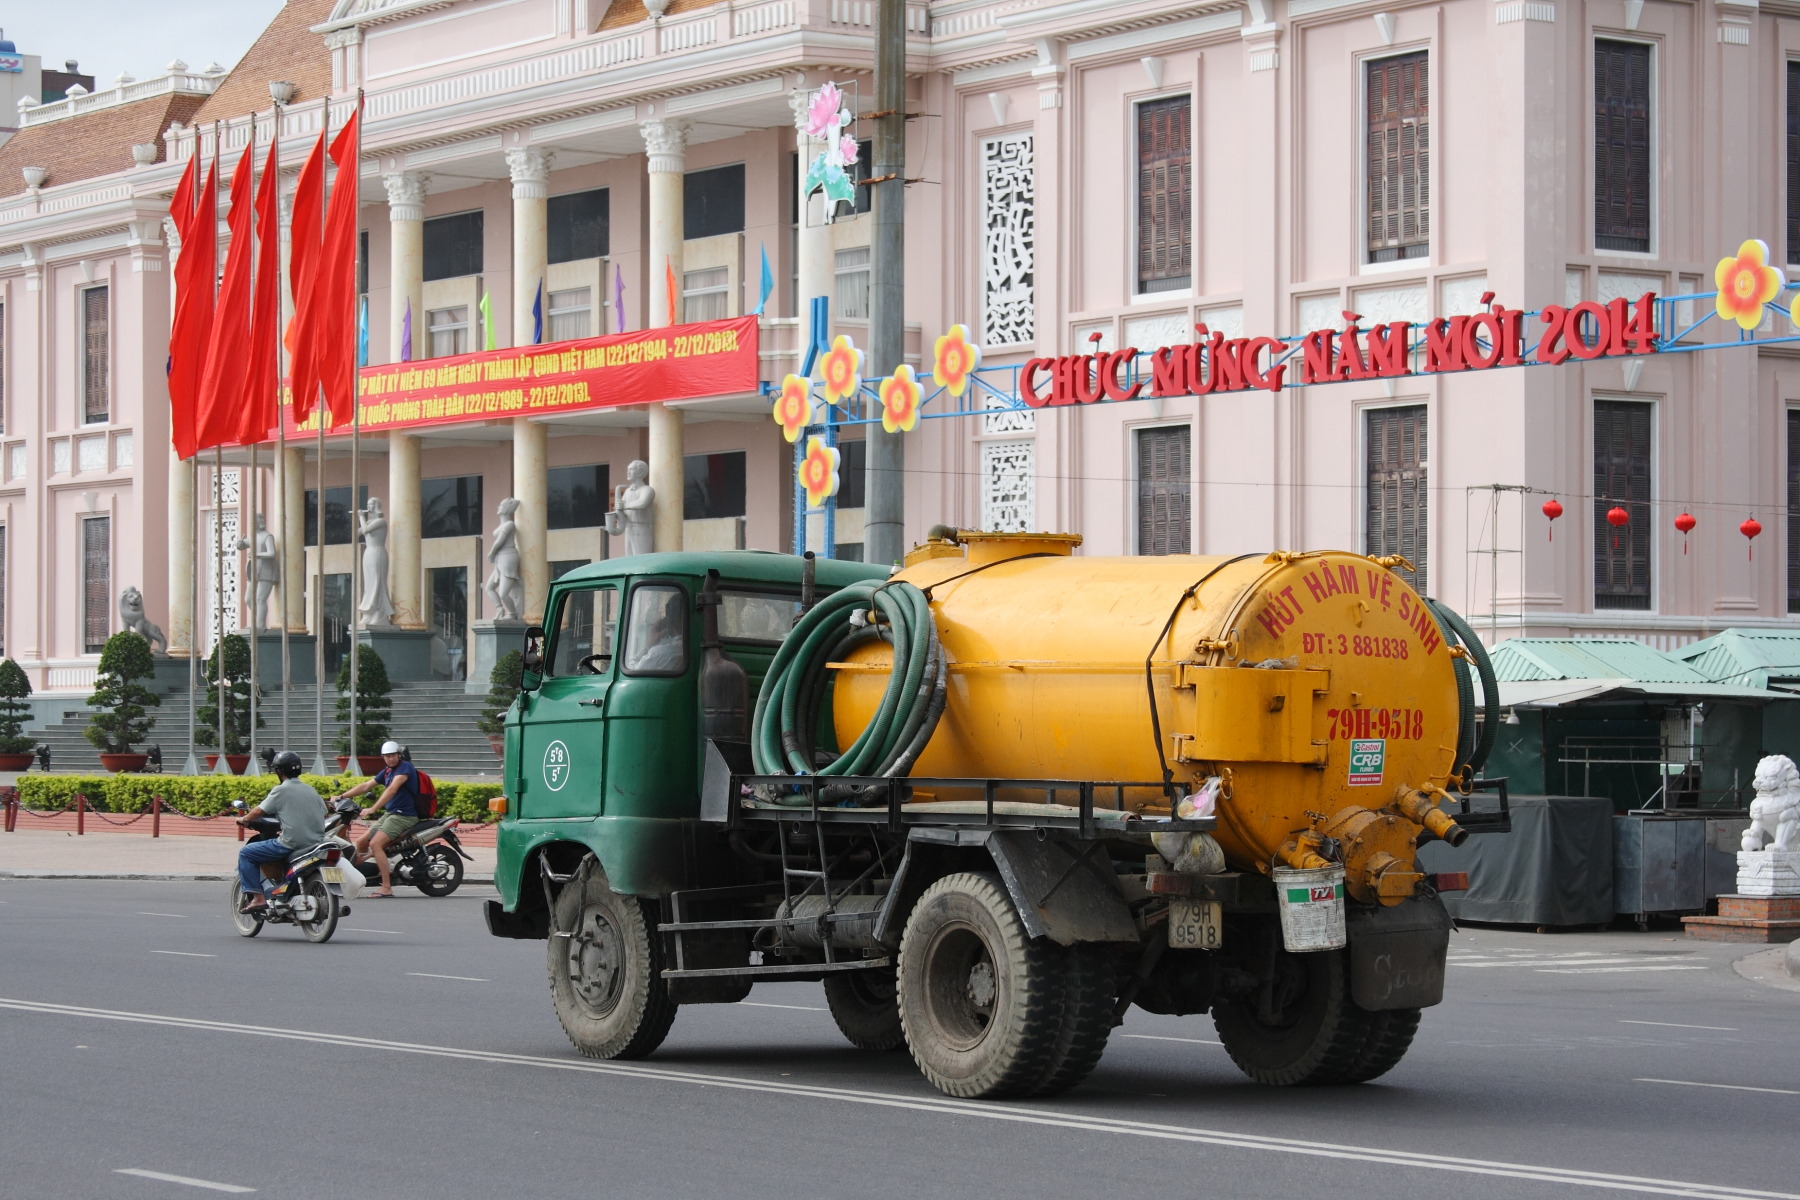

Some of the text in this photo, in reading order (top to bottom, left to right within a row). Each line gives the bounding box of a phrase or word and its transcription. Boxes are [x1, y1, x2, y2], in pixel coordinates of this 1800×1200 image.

[1019, 291, 1661, 408] CHÚC MỪNG NĂM MỚI 2014
[400, 367, 423, 394] NIỆM
[423, 368, 436, 388] 69
[458, 359, 482, 384] NGÀY
[484, 356, 514, 381] THÀNH
[515, 353, 533, 381] LẬP
[560, 347, 583, 375] VIỆT
[583, 347, 605, 370] NAM
[367, 399, 391, 427] QUỐC
[391, 397, 420, 422] PHÒNG
[421, 394, 445, 419] TOÀN
[1256, 585, 1304, 640] HÚT
[1366, 569, 1393, 613] VỆ
[1398, 592, 1441, 656] SINH
[1337, 635, 1348, 656] 3
[1353, 635, 1409, 660] 881838
[1327, 708, 1423, 741] 79H-9518
[1352, 754, 1382, 767] CRB
[1313, 887, 1331, 899] TV
[1182, 904, 1211, 924] 79H
[1176, 924, 1216, 945] 9518
